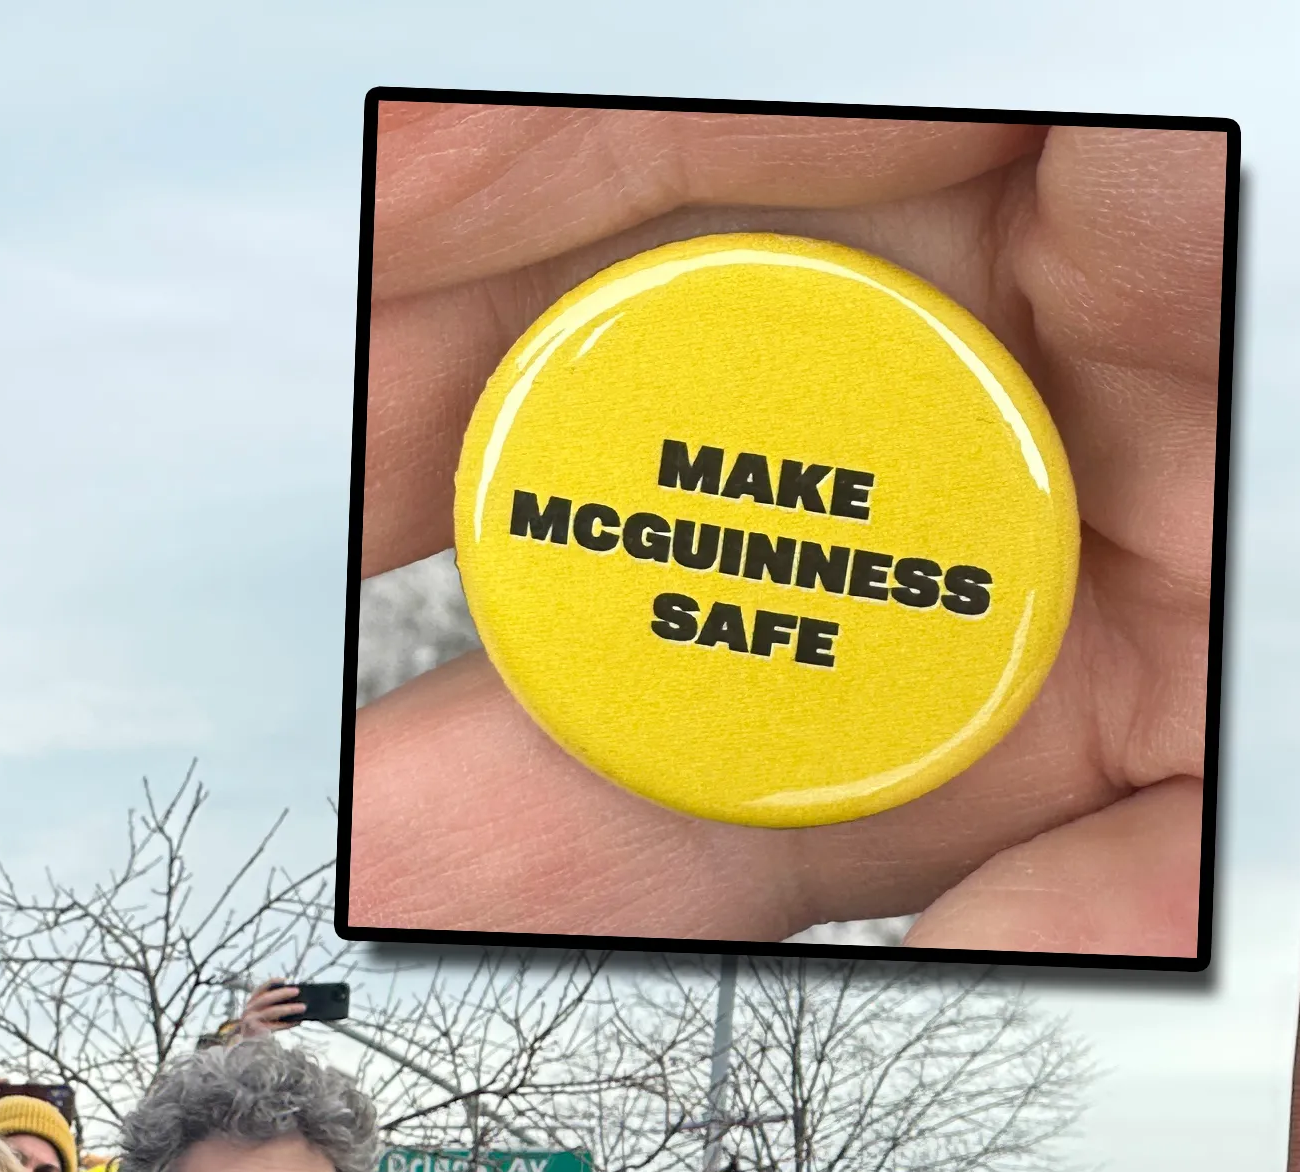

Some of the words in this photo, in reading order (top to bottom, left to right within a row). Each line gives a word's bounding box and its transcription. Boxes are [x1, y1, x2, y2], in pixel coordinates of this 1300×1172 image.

[657, 439, 875, 520] MAKE
[509, 488, 994, 617] MCGUINNESS
[651, 591, 841, 668] SAFE
